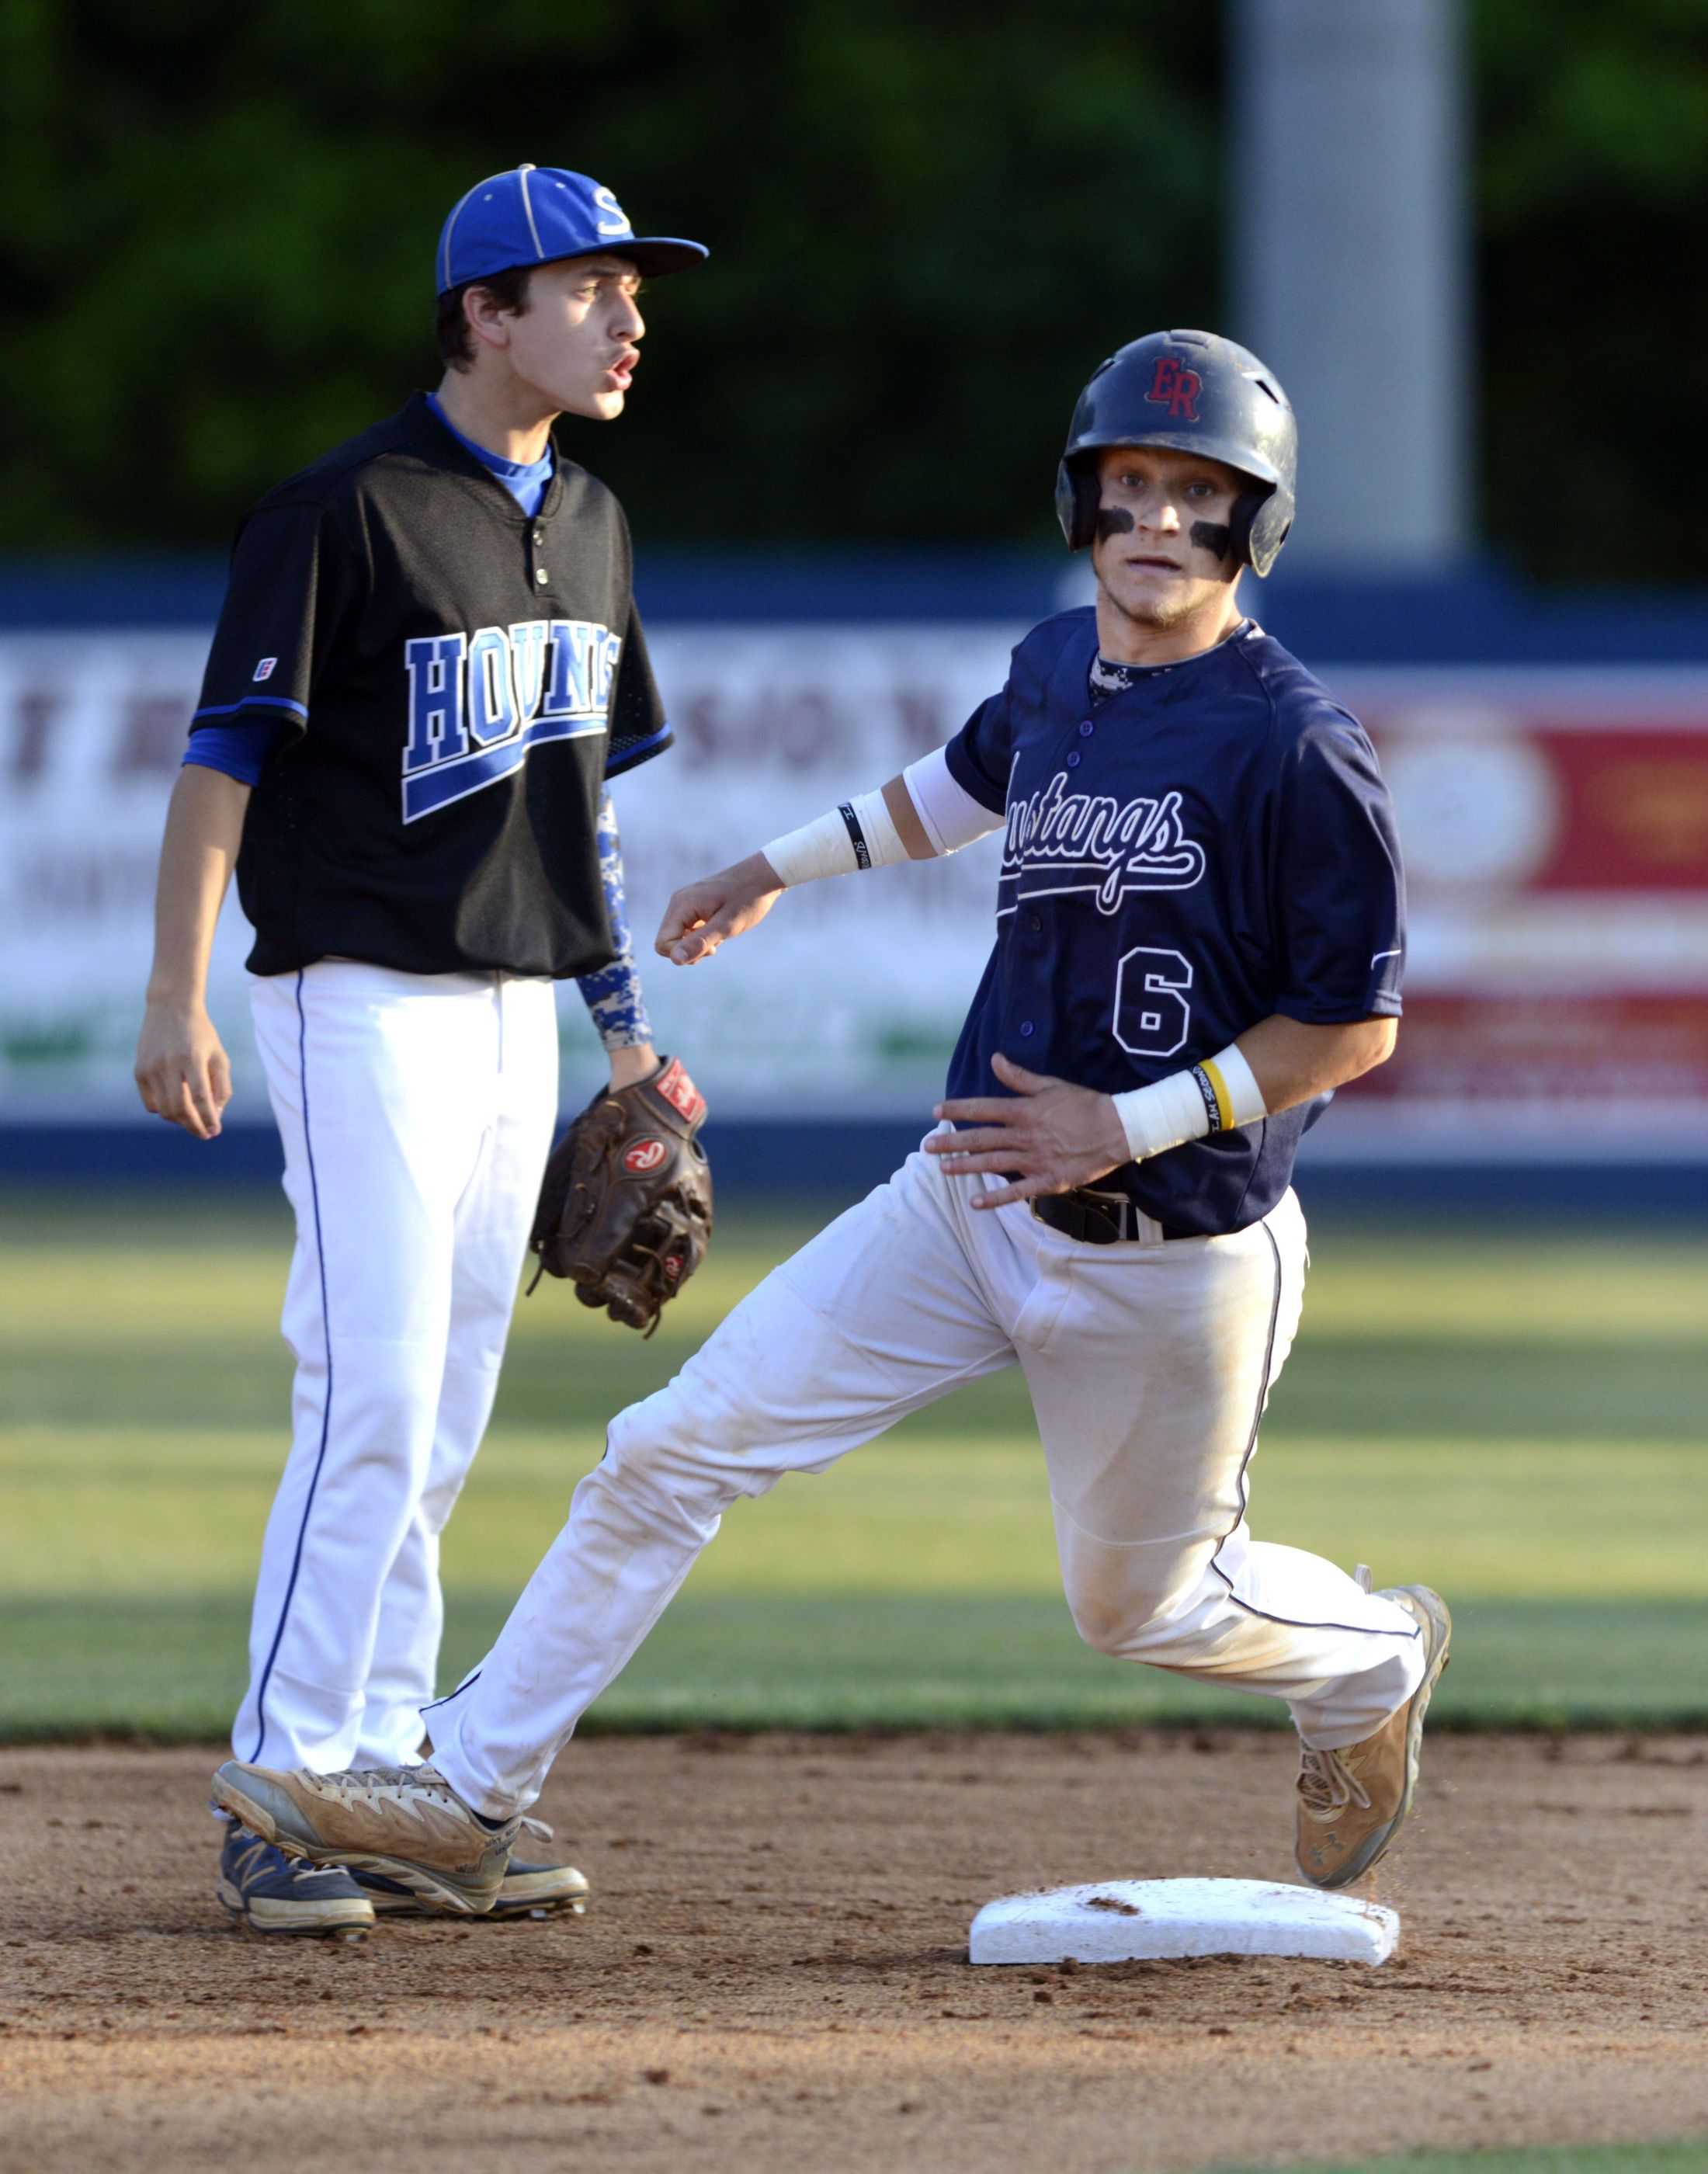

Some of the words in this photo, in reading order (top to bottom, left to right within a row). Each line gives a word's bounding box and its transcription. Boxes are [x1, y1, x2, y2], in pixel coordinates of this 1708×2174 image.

[593, 186, 631, 235] S
[1144, 356, 1203, 422] ER
[1113, 946, 1193, 1057] 6
